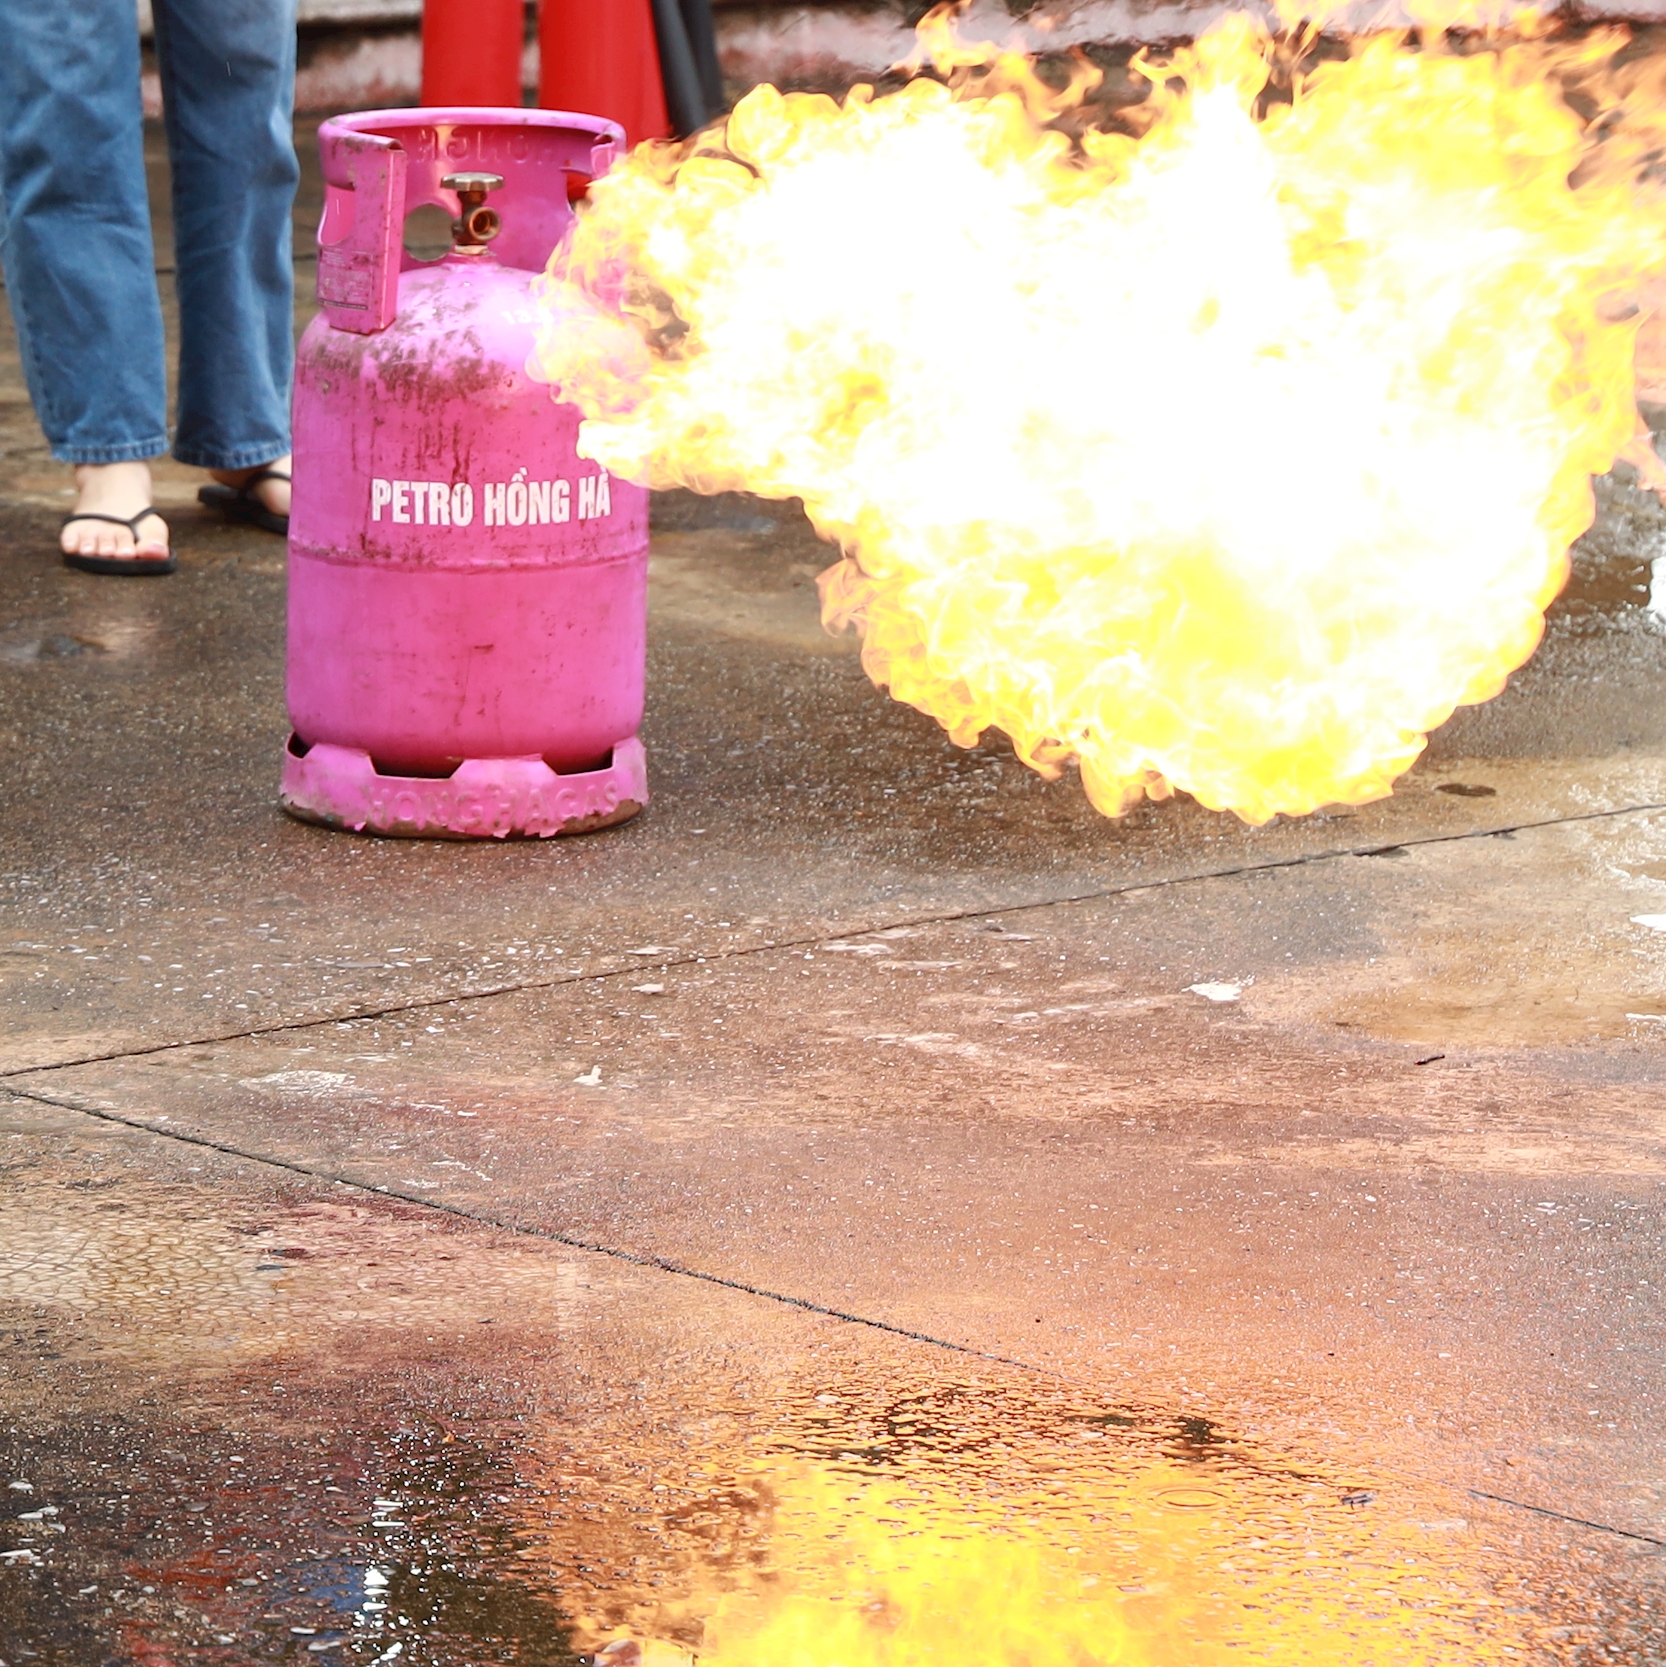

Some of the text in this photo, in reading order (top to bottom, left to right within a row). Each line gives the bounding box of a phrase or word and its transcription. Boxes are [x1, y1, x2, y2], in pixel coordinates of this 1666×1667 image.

[371, 467, 612, 527] PETRO HỒNG HÀ
